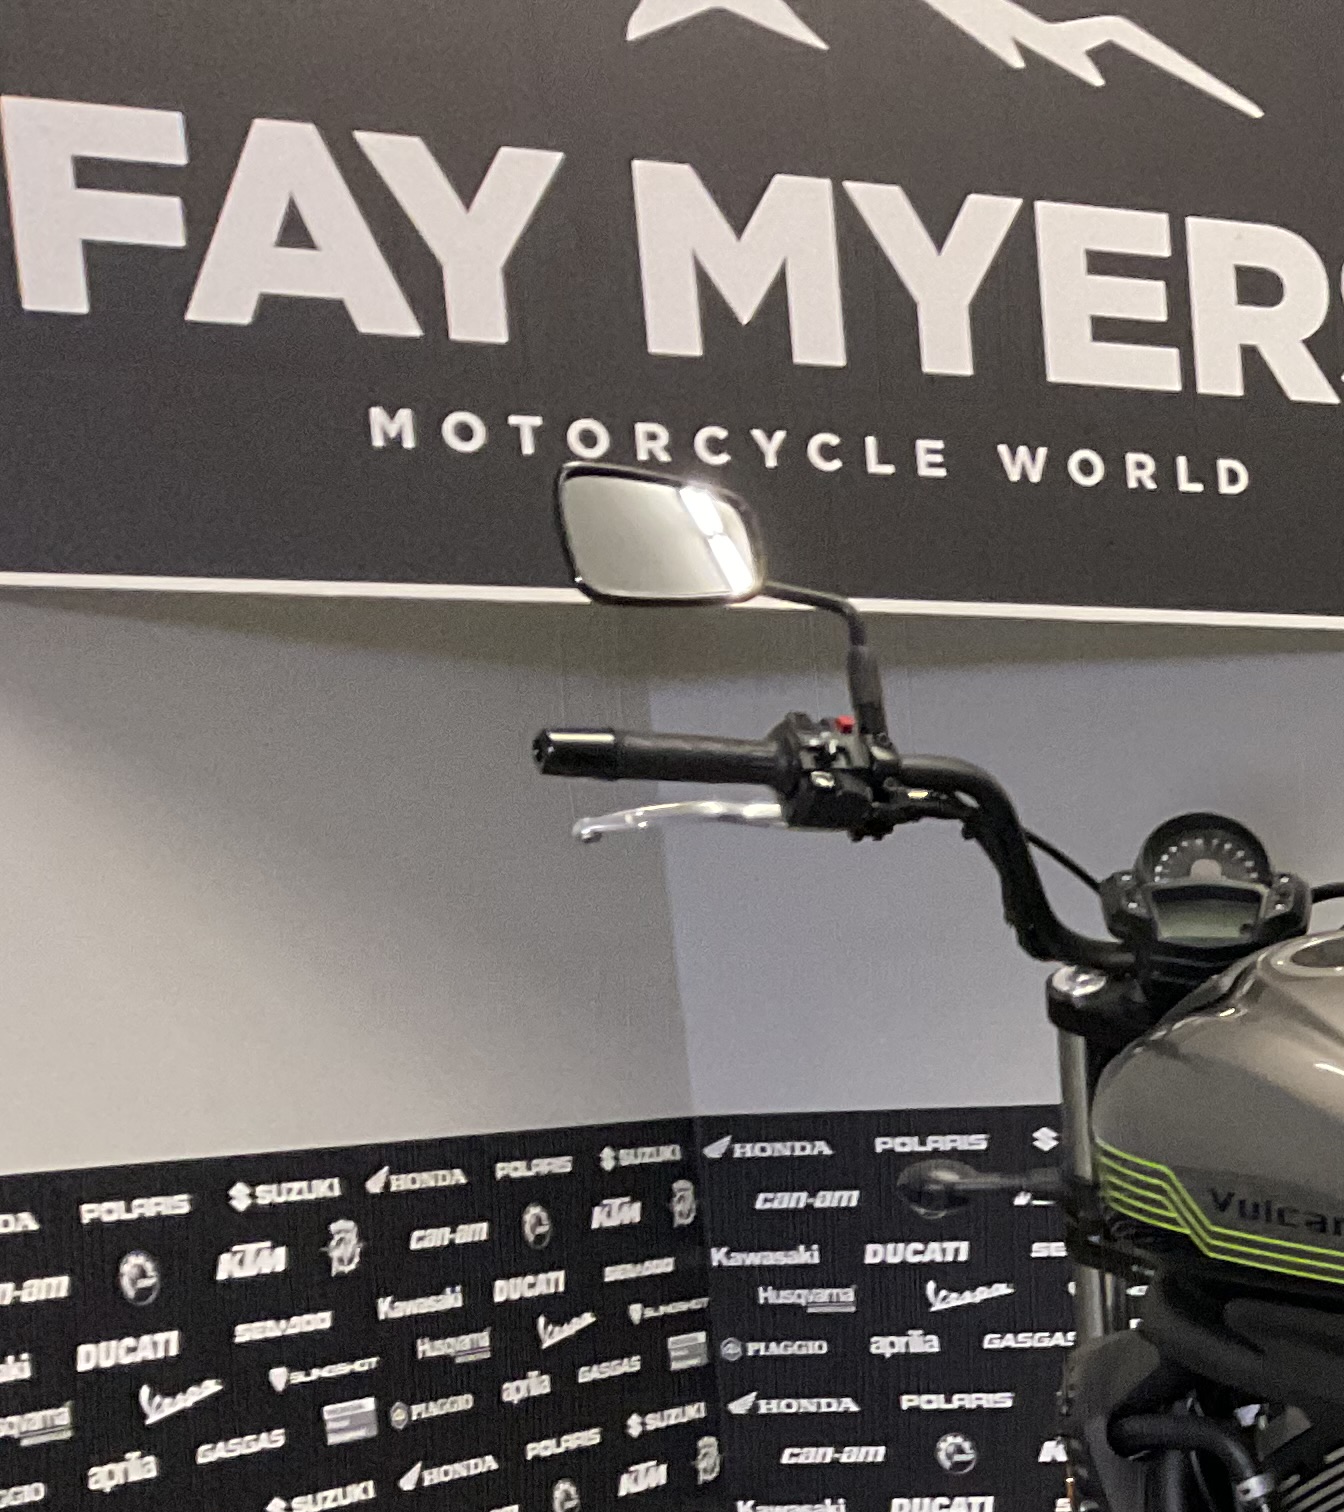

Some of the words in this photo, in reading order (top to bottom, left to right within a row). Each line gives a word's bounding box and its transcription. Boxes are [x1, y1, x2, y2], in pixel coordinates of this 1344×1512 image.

[0, 95, 565, 344] FAY
[370, 407, 947, 479] MOTORCYCLE
[997, 444, 1248, 494] WORLD
[618, 1145, 681, 1166] SUZUKI
[732, 1141, 833, 1157] HONDA
[875, 1134, 989, 1153] POLARIS
[389, 1169, 467, 1192] HONDA
[496, 1156, 572, 1179] POLARIS
[255, 1177, 341, 1204] SUZUKI
[755, 1190, 860, 1209] can-am
[80, 1194, 191, 1224] POLARIS
[591, 1197, 641, 1229] KTM
[216, 1241, 286, 1280] KTM
[711, 1245, 820, 1266] Kawasaki
[864, 1241, 969, 1264] DUCATI
[493, 1270, 565, 1302] DUCATI
[758, 1285, 856, 1306] Husqvarna
[926, 1280, 1014, 1311] Vespa
[77, 1330, 179, 1372] DUCATI
[746, 1341, 827, 1356] PIAGGIO
[870, 1330, 940, 1358] aprilia
[578, 1355, 641, 1383] GASGAS
[410, 1394, 473, 1420] PIAGGIO
[757, 1398, 860, 1413] HONDA
[900, 1392, 1014, 1410] POLARIS
[644, 1402, 706, 1430] SUZUKI
[197, 1429, 285, 1464] GASGAS
[526, 1428, 600, 1460] POLARIS
[780, 1446, 886, 1464] can-am
[422, 1455, 499, 1486] HONDA
[618, 1460, 667, 1496] KTM
